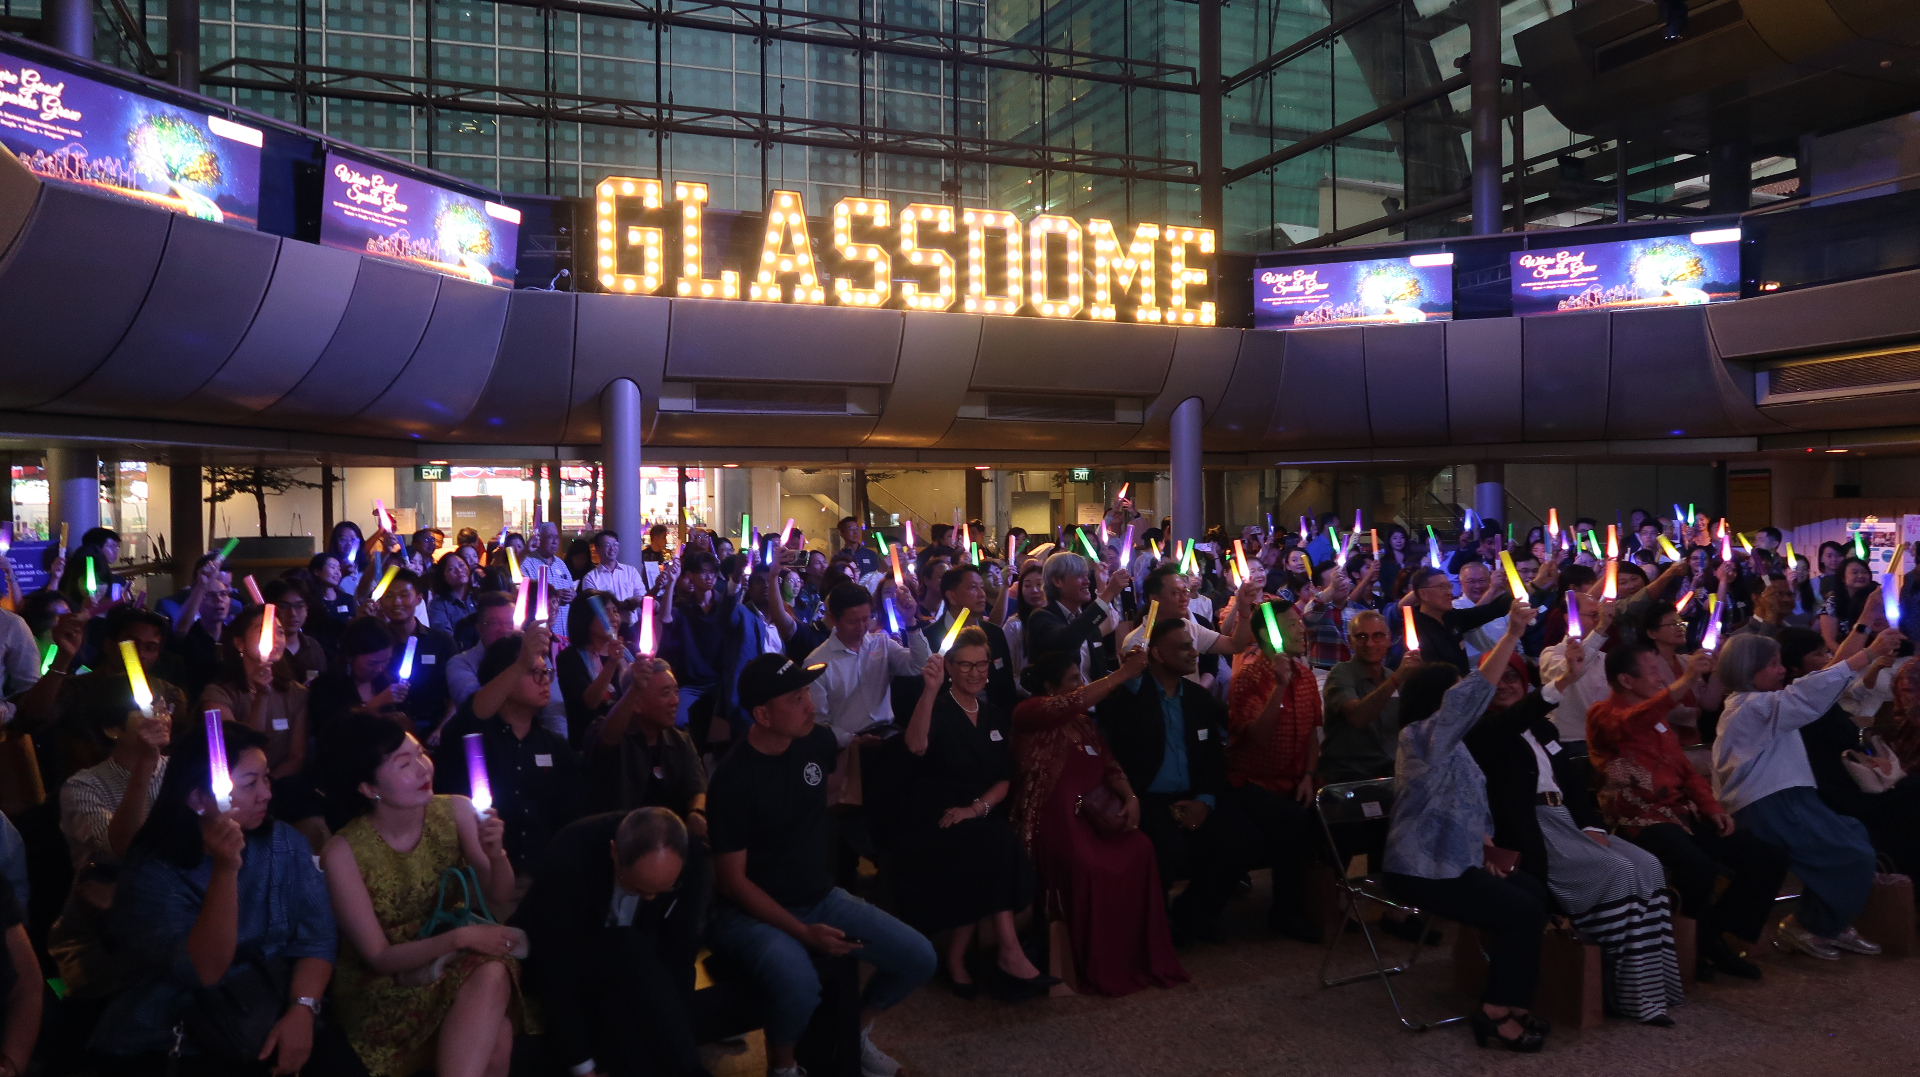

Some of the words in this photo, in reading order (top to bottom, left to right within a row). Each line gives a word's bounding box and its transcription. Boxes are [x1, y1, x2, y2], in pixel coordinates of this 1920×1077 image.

[19, 68, 65, 97] Good
[334, 164, 370, 187] Where
[370, 174, 398, 195] Good
[596, 176, 1217, 326] GLASSDOME
[1519, 254, 1556, 268] Where
[422, 468, 443, 480] EXIT
[1073, 471, 1090, 481] EXIT
